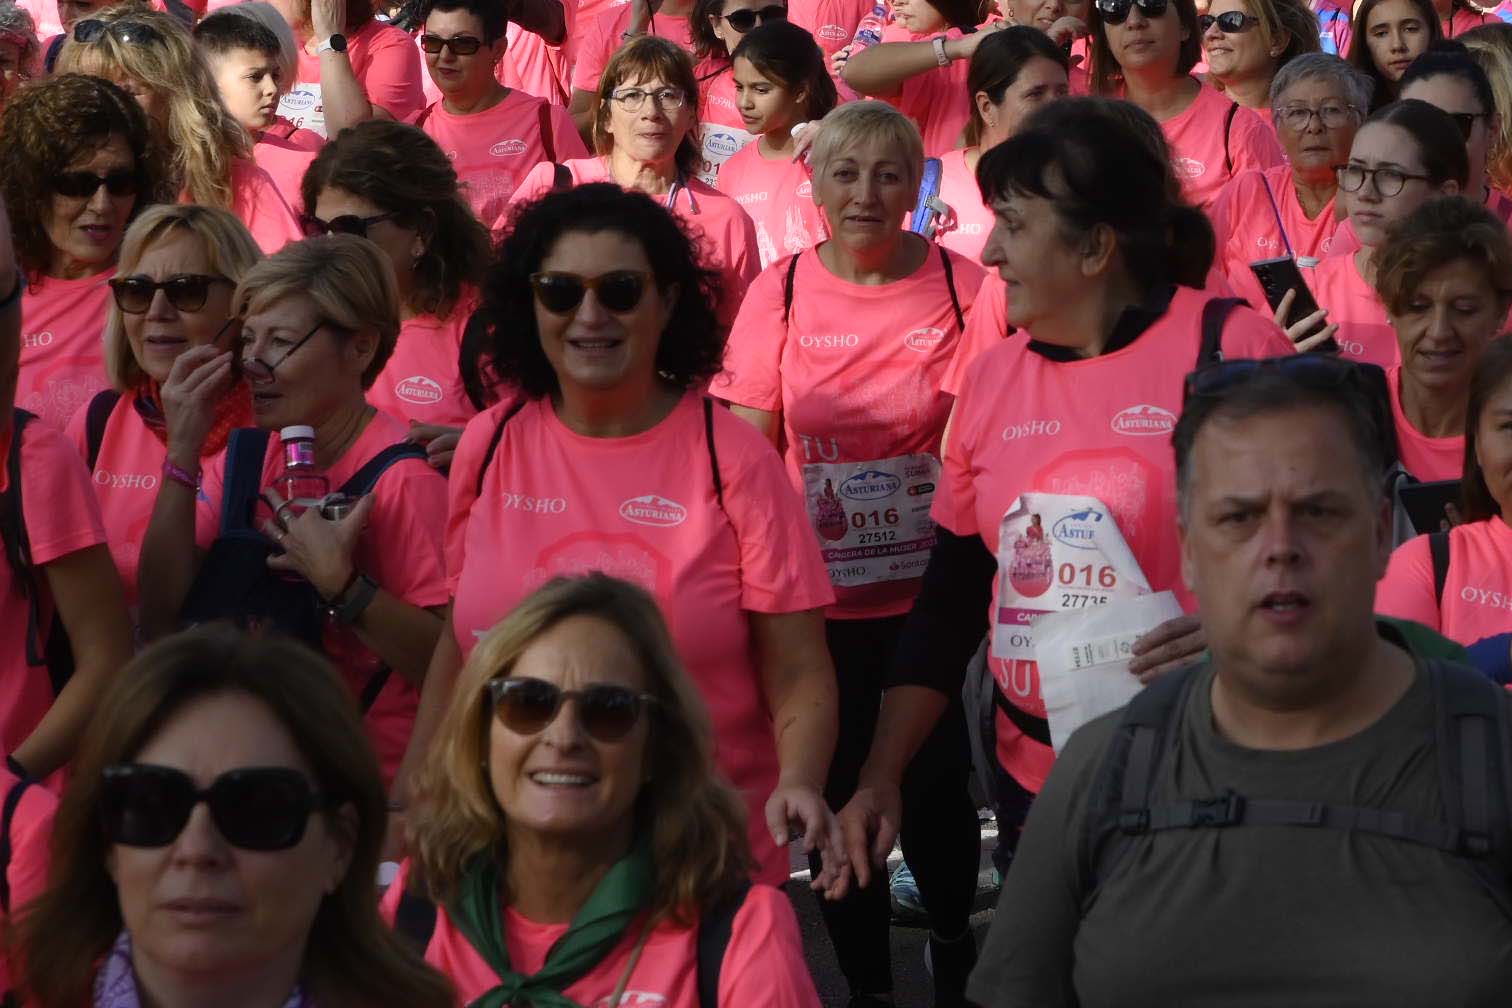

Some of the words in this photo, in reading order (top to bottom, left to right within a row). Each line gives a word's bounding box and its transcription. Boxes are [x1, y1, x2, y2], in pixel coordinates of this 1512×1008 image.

[800, 334, 859, 348] OYSHO
[1002, 419, 1062, 441] OYSHO
[1117, 415, 1171, 430] ASTURIANA
[798, 433, 839, 461] TU
[94, 470, 156, 489] OYSHO
[843, 481, 898, 495] ASTURIANA
[626, 503, 684, 522] ASTURIANA
[851, 508, 899, 529] 016
[859, 530, 896, 544] 27512
[1058, 562, 1118, 589] 016
